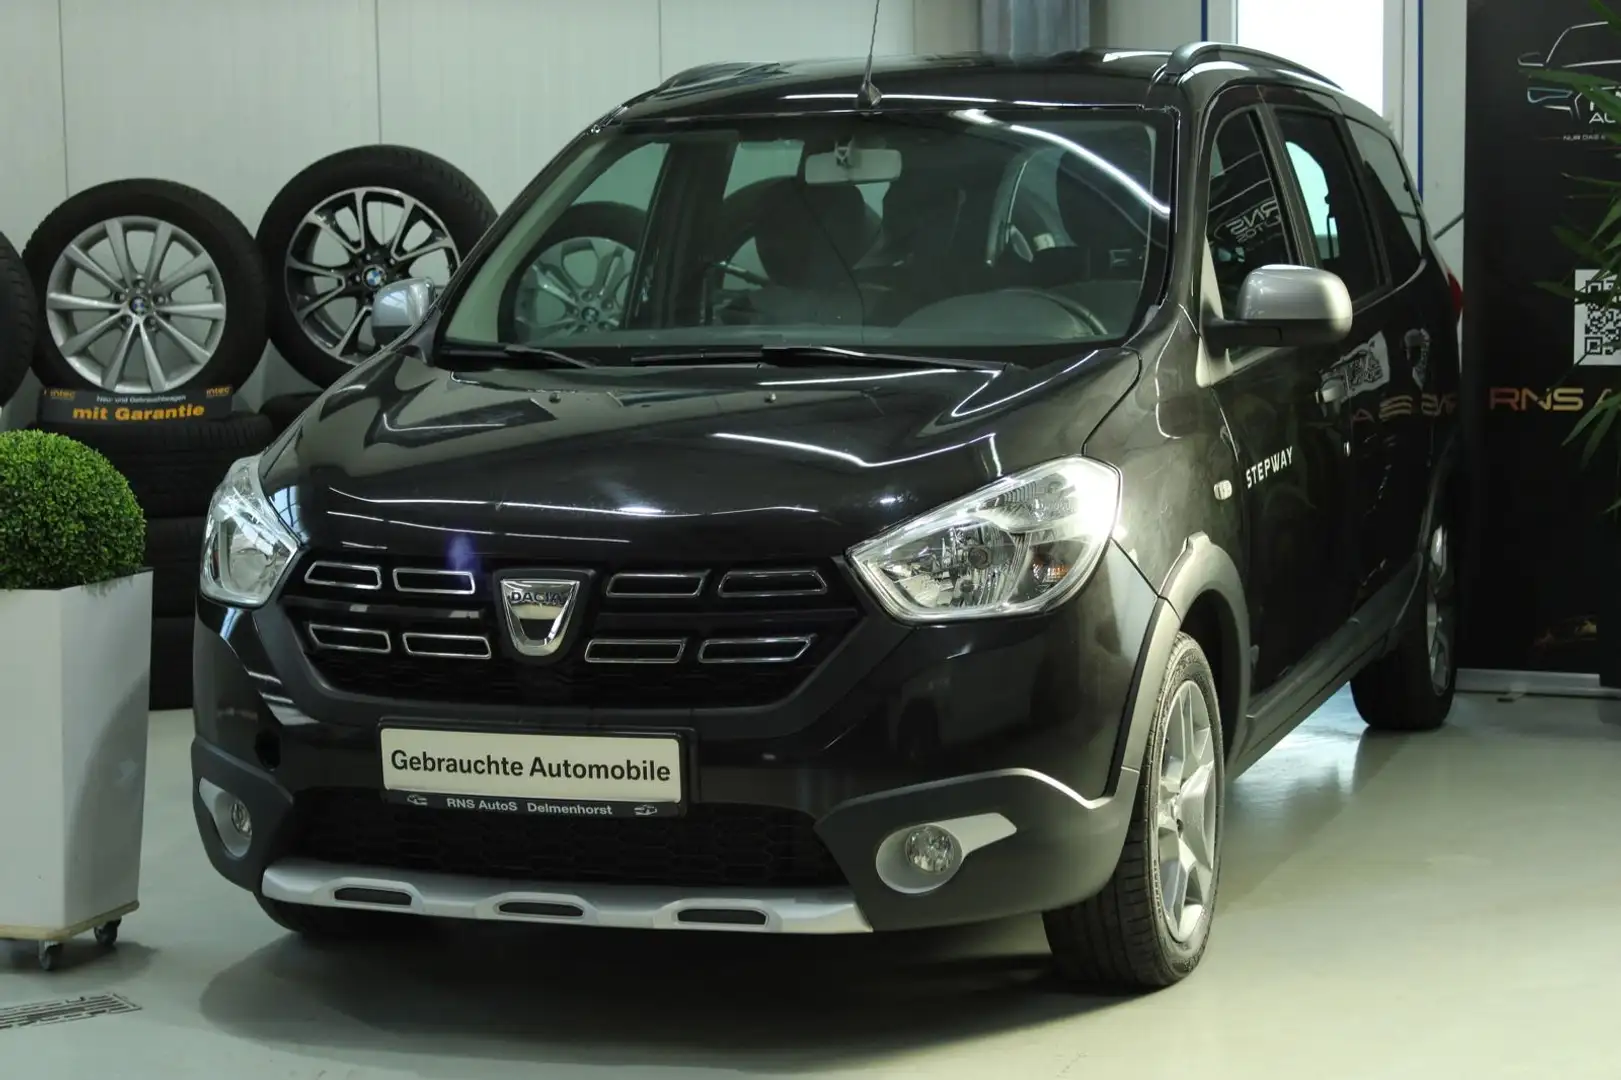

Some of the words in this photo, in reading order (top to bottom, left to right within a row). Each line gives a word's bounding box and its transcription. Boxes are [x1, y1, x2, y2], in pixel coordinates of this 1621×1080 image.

[206, 386, 231, 396] intec
[1489, 387, 1584, 411] RNS
[72, 406, 108, 421] mit
[114, 404, 205, 421] Garantie
[1246, 446, 1293, 489] STEPWAY
[510, 591, 564, 603] DACIA
[391, 749, 524, 777] Gebrauchte
[529, 756, 671, 782] Automobile
[447, 798, 475, 809] RNS
[478, 800, 518, 812] AutoS
[527, 802, 613, 816] Delmenhorst
